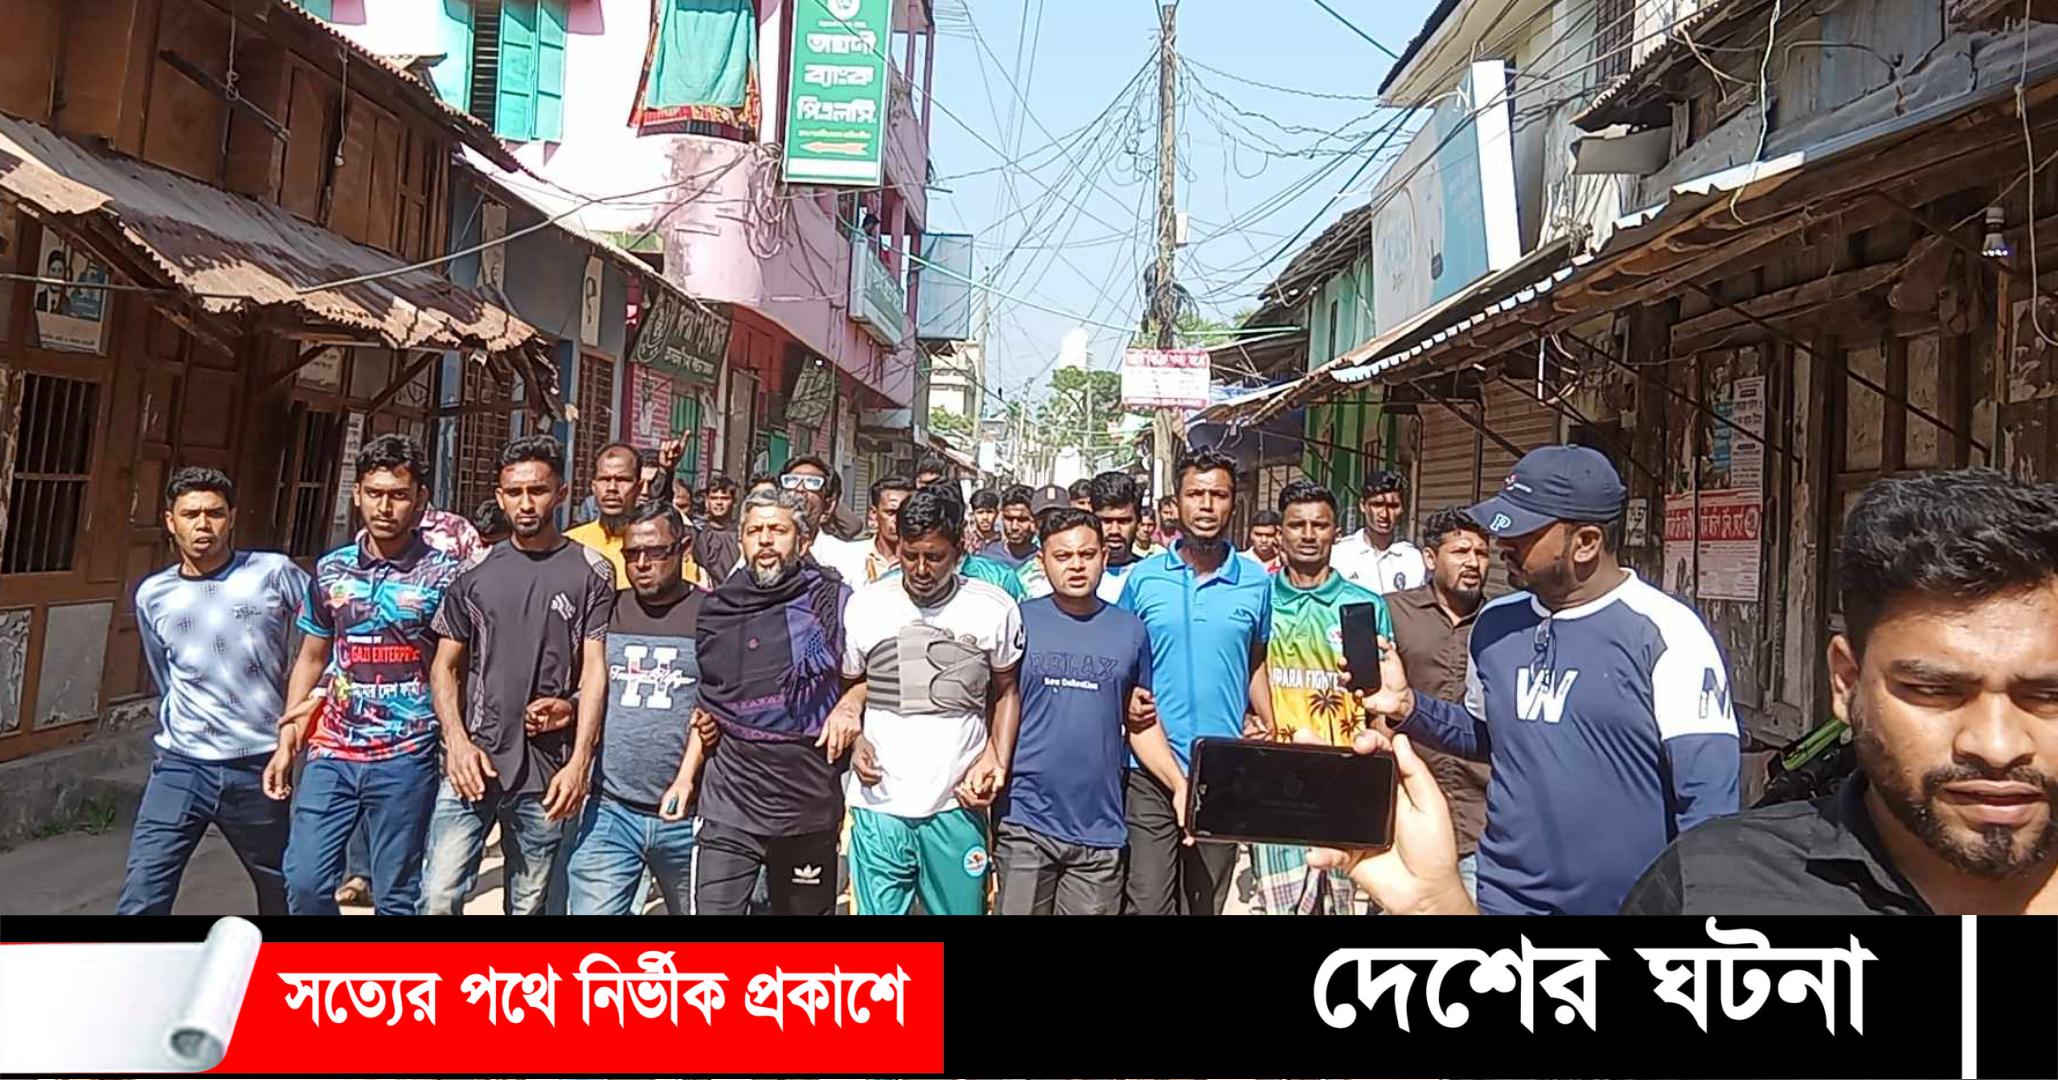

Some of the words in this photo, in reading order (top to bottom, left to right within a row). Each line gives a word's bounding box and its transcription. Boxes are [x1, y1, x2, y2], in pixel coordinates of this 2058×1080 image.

[804, 63, 875, 88] ব্যাংক
[351, 645, 371, 662] GAZI
[1029, 651, 1119, 682] RELAX
